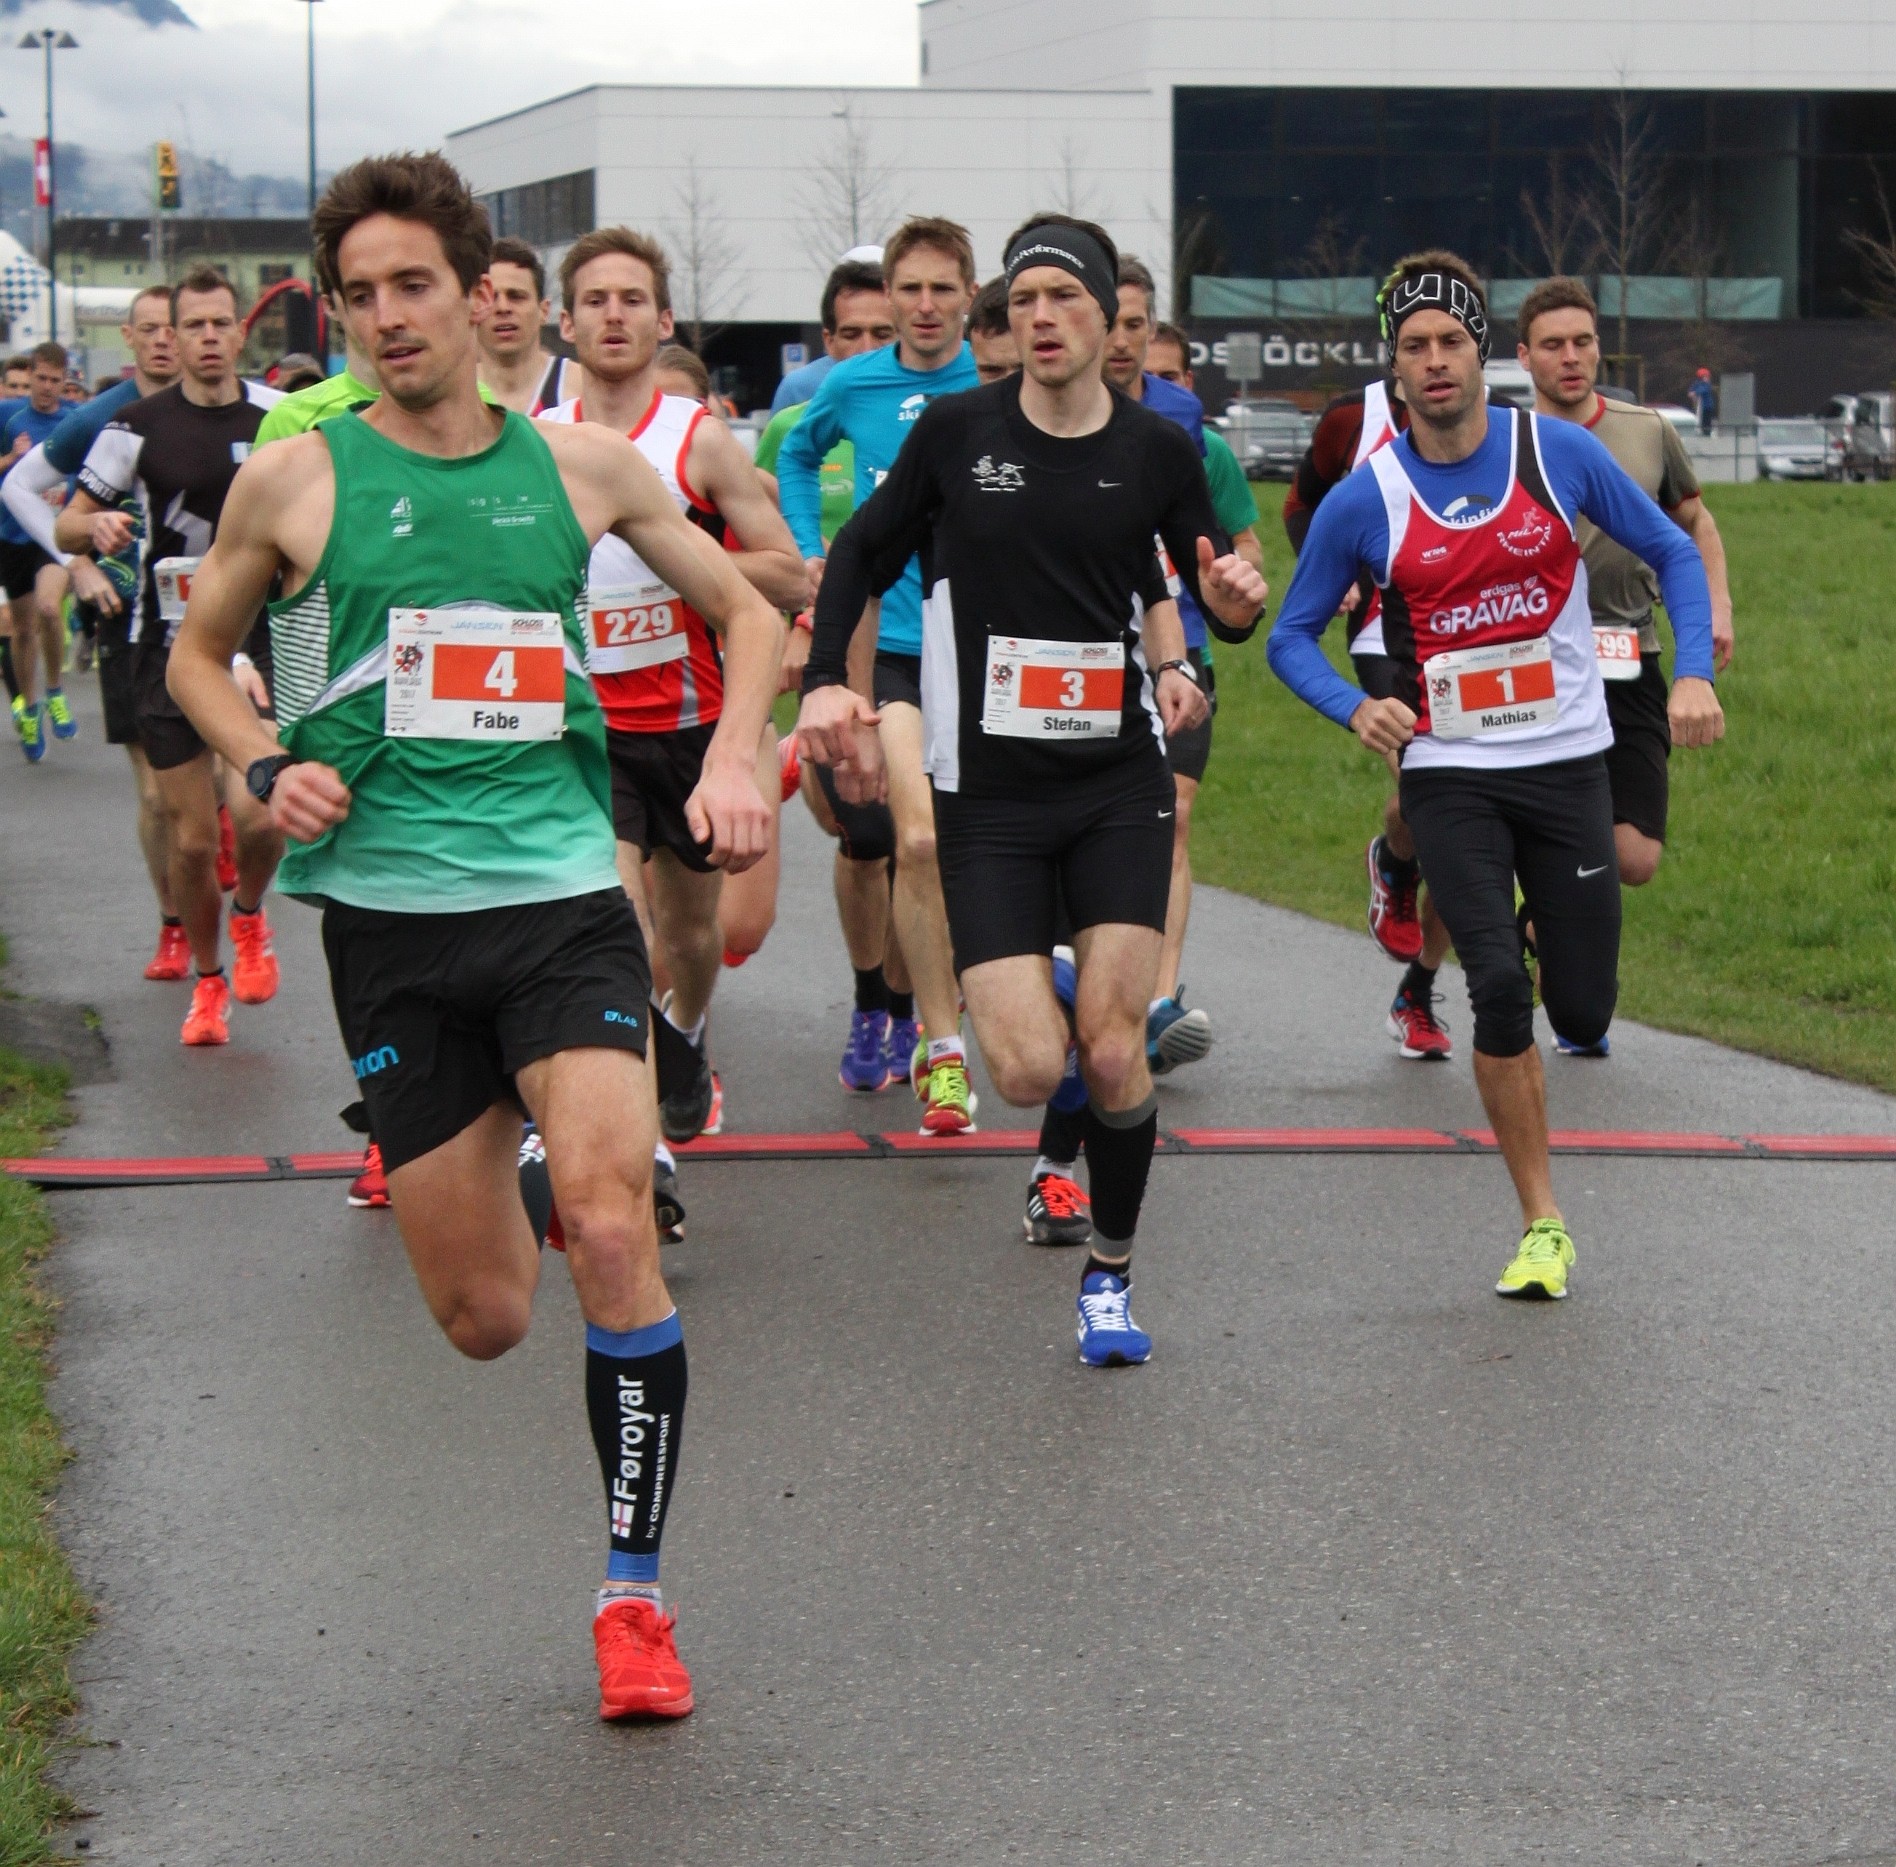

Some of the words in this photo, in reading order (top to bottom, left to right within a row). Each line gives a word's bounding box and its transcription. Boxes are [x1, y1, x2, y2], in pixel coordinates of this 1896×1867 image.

[898, 408, 920, 421] ski
[1480, 582, 1521, 599] erdgas
[605, 604, 674, 644] 229
[1429, 587, 1549, 635] GRAVAG
[484, 650, 518, 697] 4
[1059, 670, 1085, 708] 3
[1496, 669, 1515, 703] 1
[472, 711, 519, 729] Fabe
[1043, 716, 1091, 732] Stefan
[1481, 710, 1537, 728] Mathias
[613, 1374, 655, 1501] Føroyar
[651, 1413, 670, 1522] COMPRESSPORT
[646, 1526, 657, 1538] by
